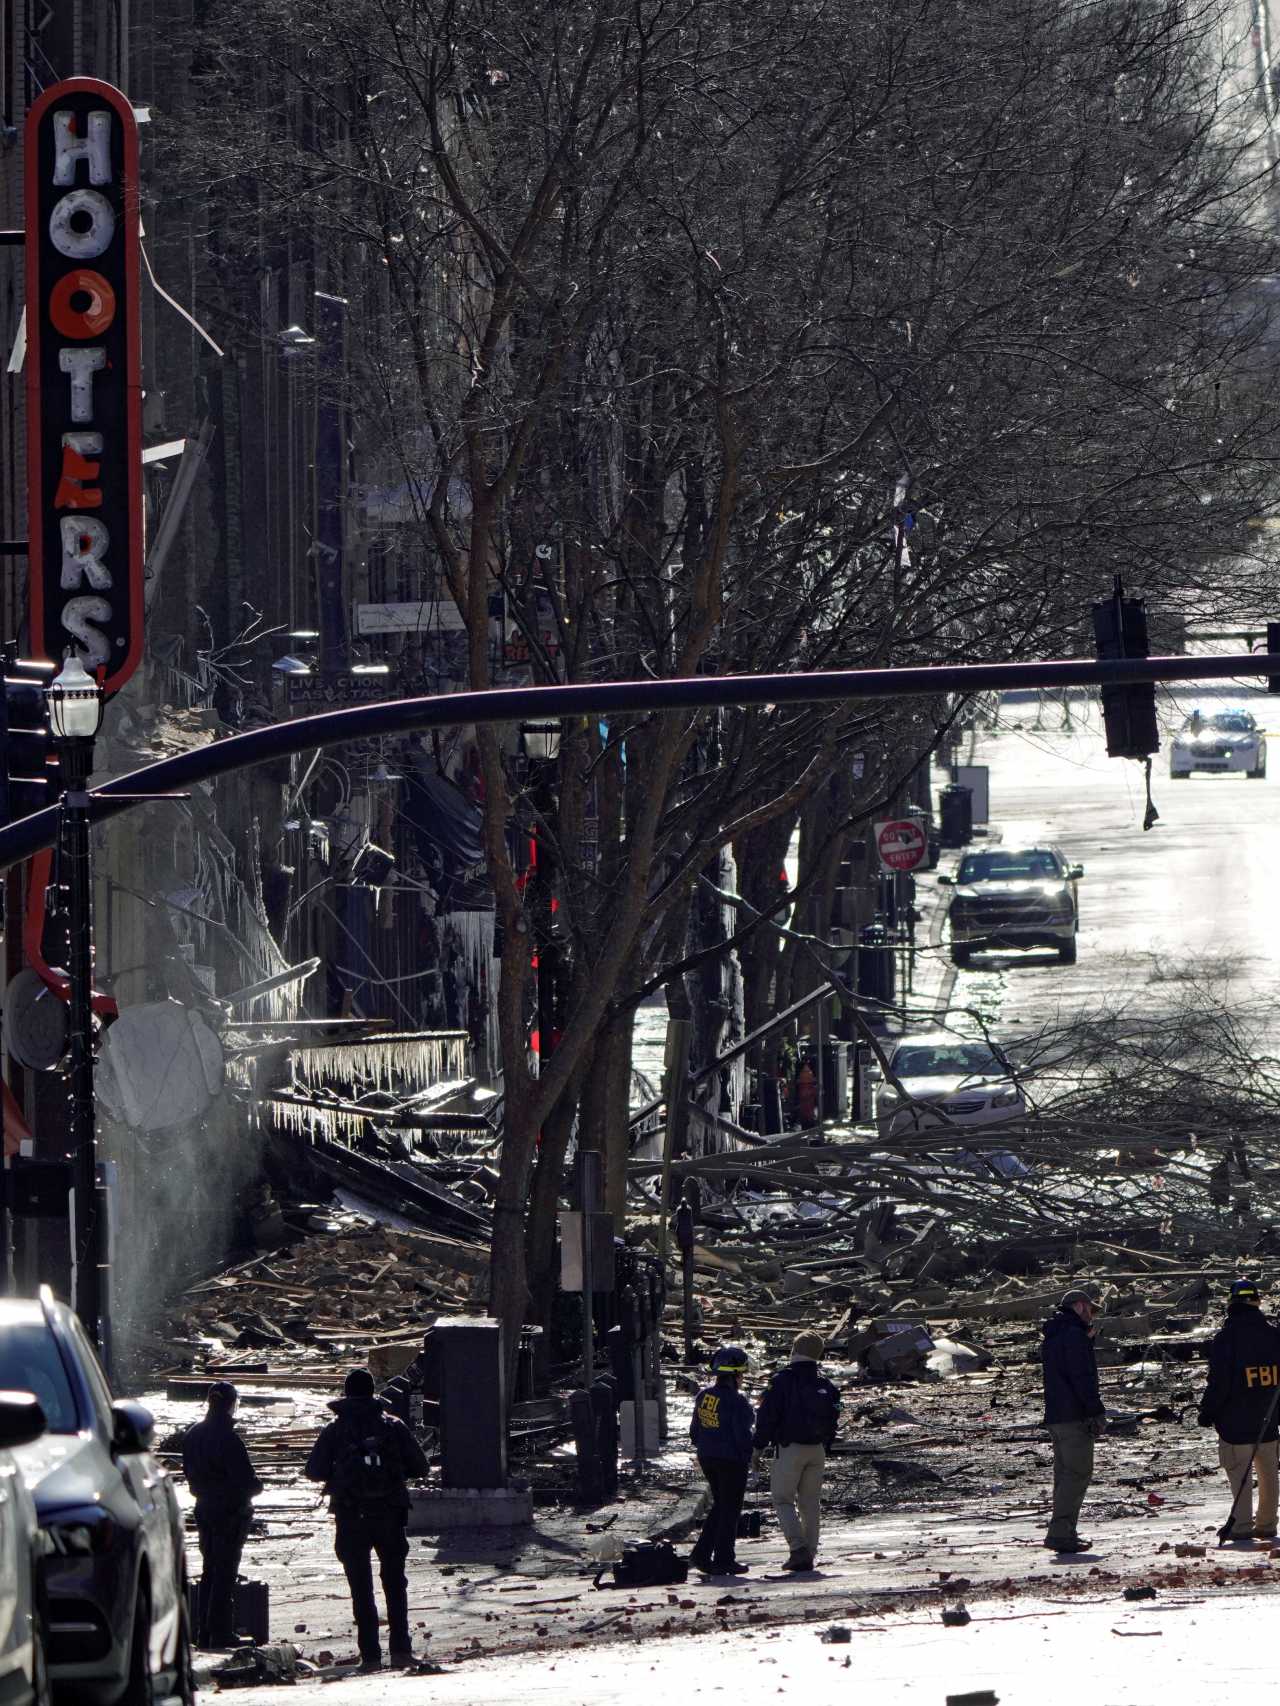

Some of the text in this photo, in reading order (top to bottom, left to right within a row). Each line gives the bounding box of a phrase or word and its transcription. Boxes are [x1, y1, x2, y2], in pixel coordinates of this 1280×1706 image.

[49, 110, 116, 672] HOOTERS
[1245, 1364, 1279, 1388] FBI
[700, 1394, 720, 1412] FBI
